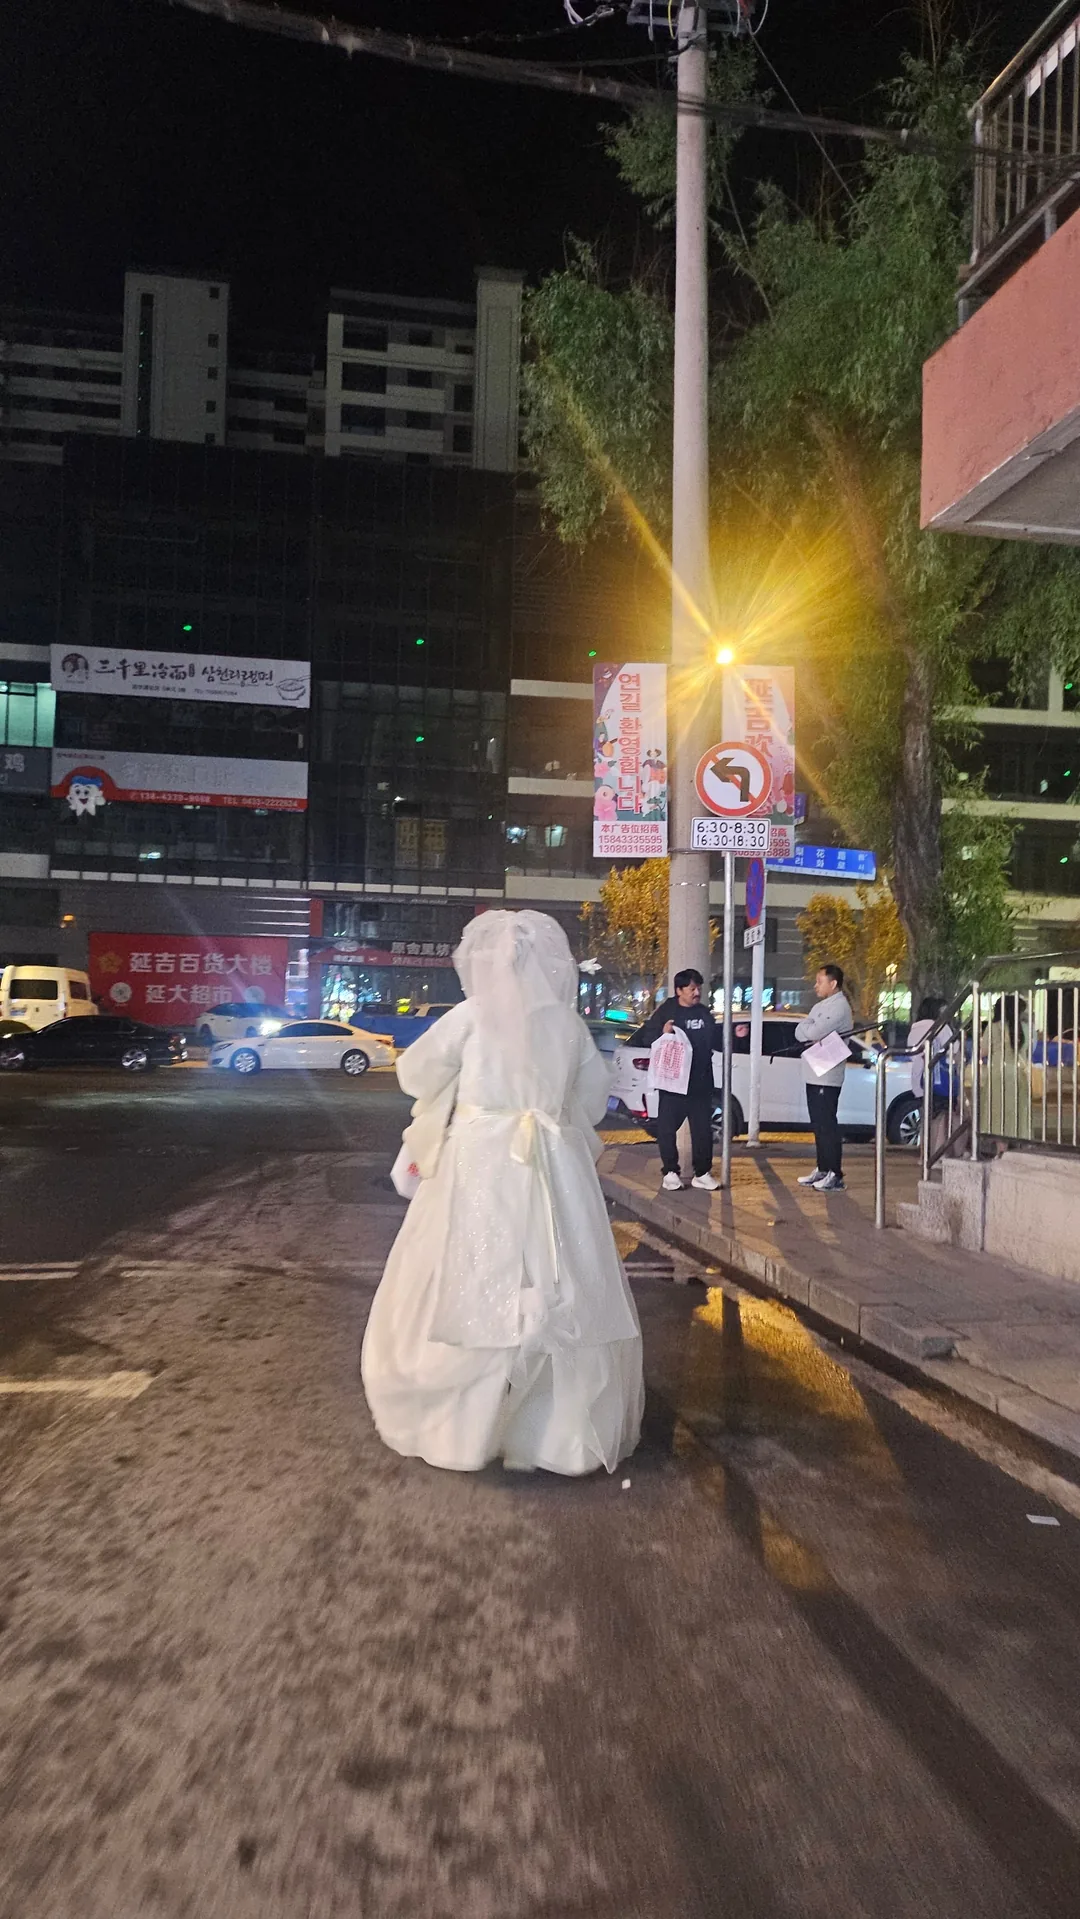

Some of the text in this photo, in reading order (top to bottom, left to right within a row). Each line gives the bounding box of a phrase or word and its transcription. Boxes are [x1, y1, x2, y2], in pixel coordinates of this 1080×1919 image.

[617, 673, 643, 815] 연길 환영합니다
[601, 824, 660, 834] 本广告位招商
[697, 821, 766, 835] 6:30-8:30
[598, 835, 663, 844] 15843335595
[696, 834, 765, 847] 16:30-18:30
[129, 952, 273, 976] 延吉百货大楼
[145, 984, 233, 1005] 延大超市
